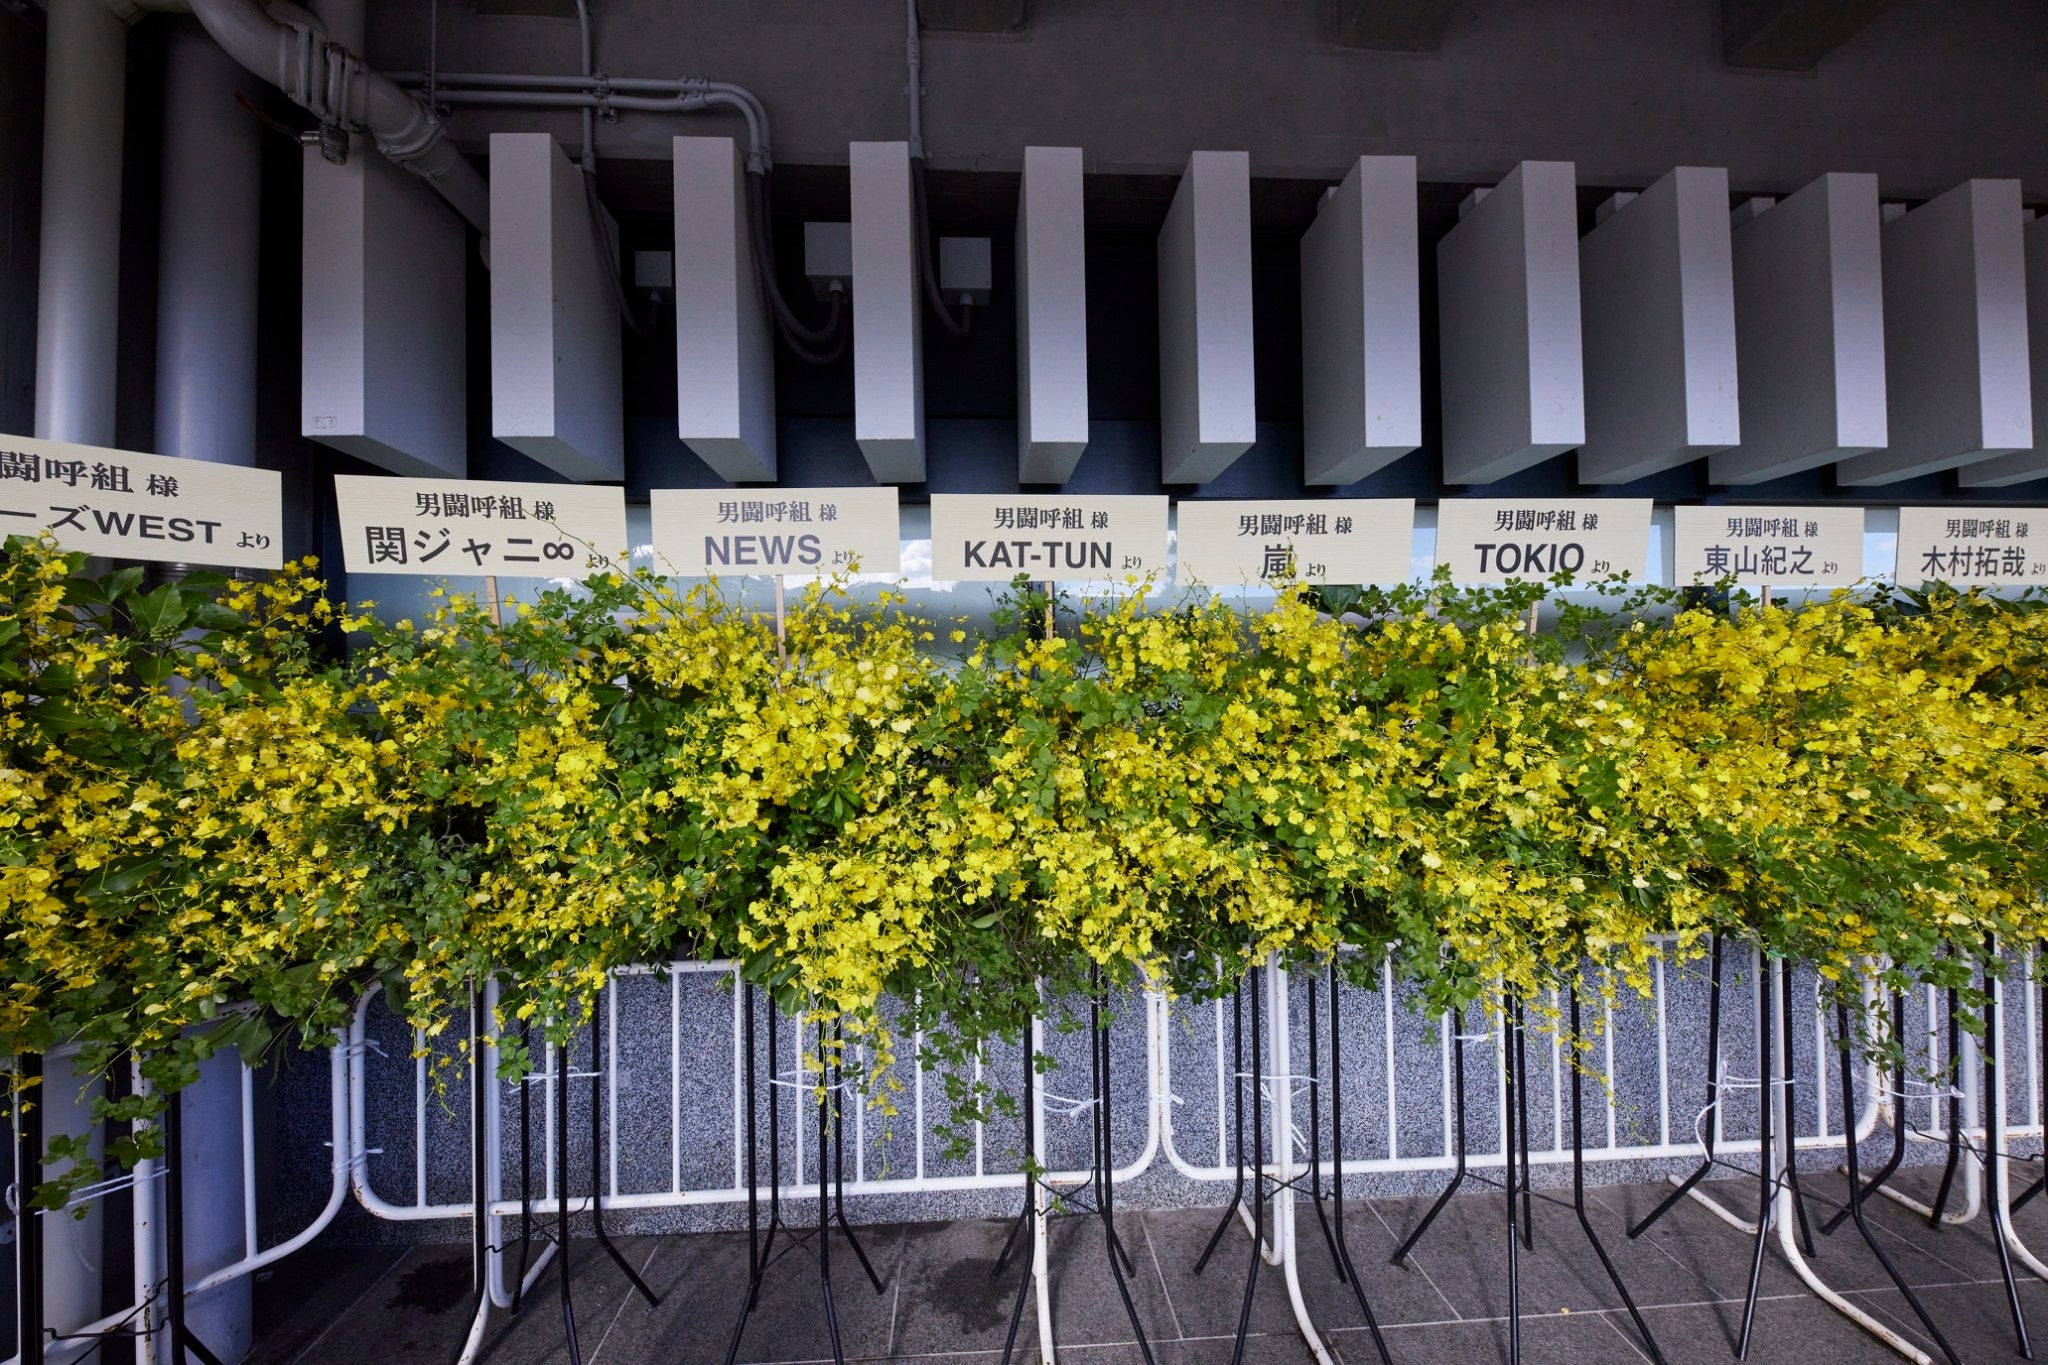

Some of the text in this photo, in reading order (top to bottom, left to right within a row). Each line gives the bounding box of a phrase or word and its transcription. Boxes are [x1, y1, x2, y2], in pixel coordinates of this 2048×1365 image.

[146, 474, 179, 498] 様
[415, 492, 555, 521] 男闘呼組 様
[717, 500, 837, 523] 男闘呼組 様
[993, 507, 1109, 529] 男闘呼組 様
[1238, 513, 1353, 536] 男闘呼組 様
[1494, 509, 1599, 531] 男闘呼組 様
[1726, 517, 1818, 538] 男闘呼組 様
[1945, 519, 2028, 538] 男闘呼組 様
[236, 531, 270, 549] より
[365, 526, 610, 569] 関ジャニ∞ より
[704, 534, 853, 566] NEWS より
[964, 540, 1142, 570] KAT-TUN より
[1261, 543, 1326, 579] 嵐 より
[1474, 542, 1610, 574] TOKIO より
[1703, 544, 1838, 576] 東山紀之 より
[1921, 545, 2046, 577] 木村拓哉 より
